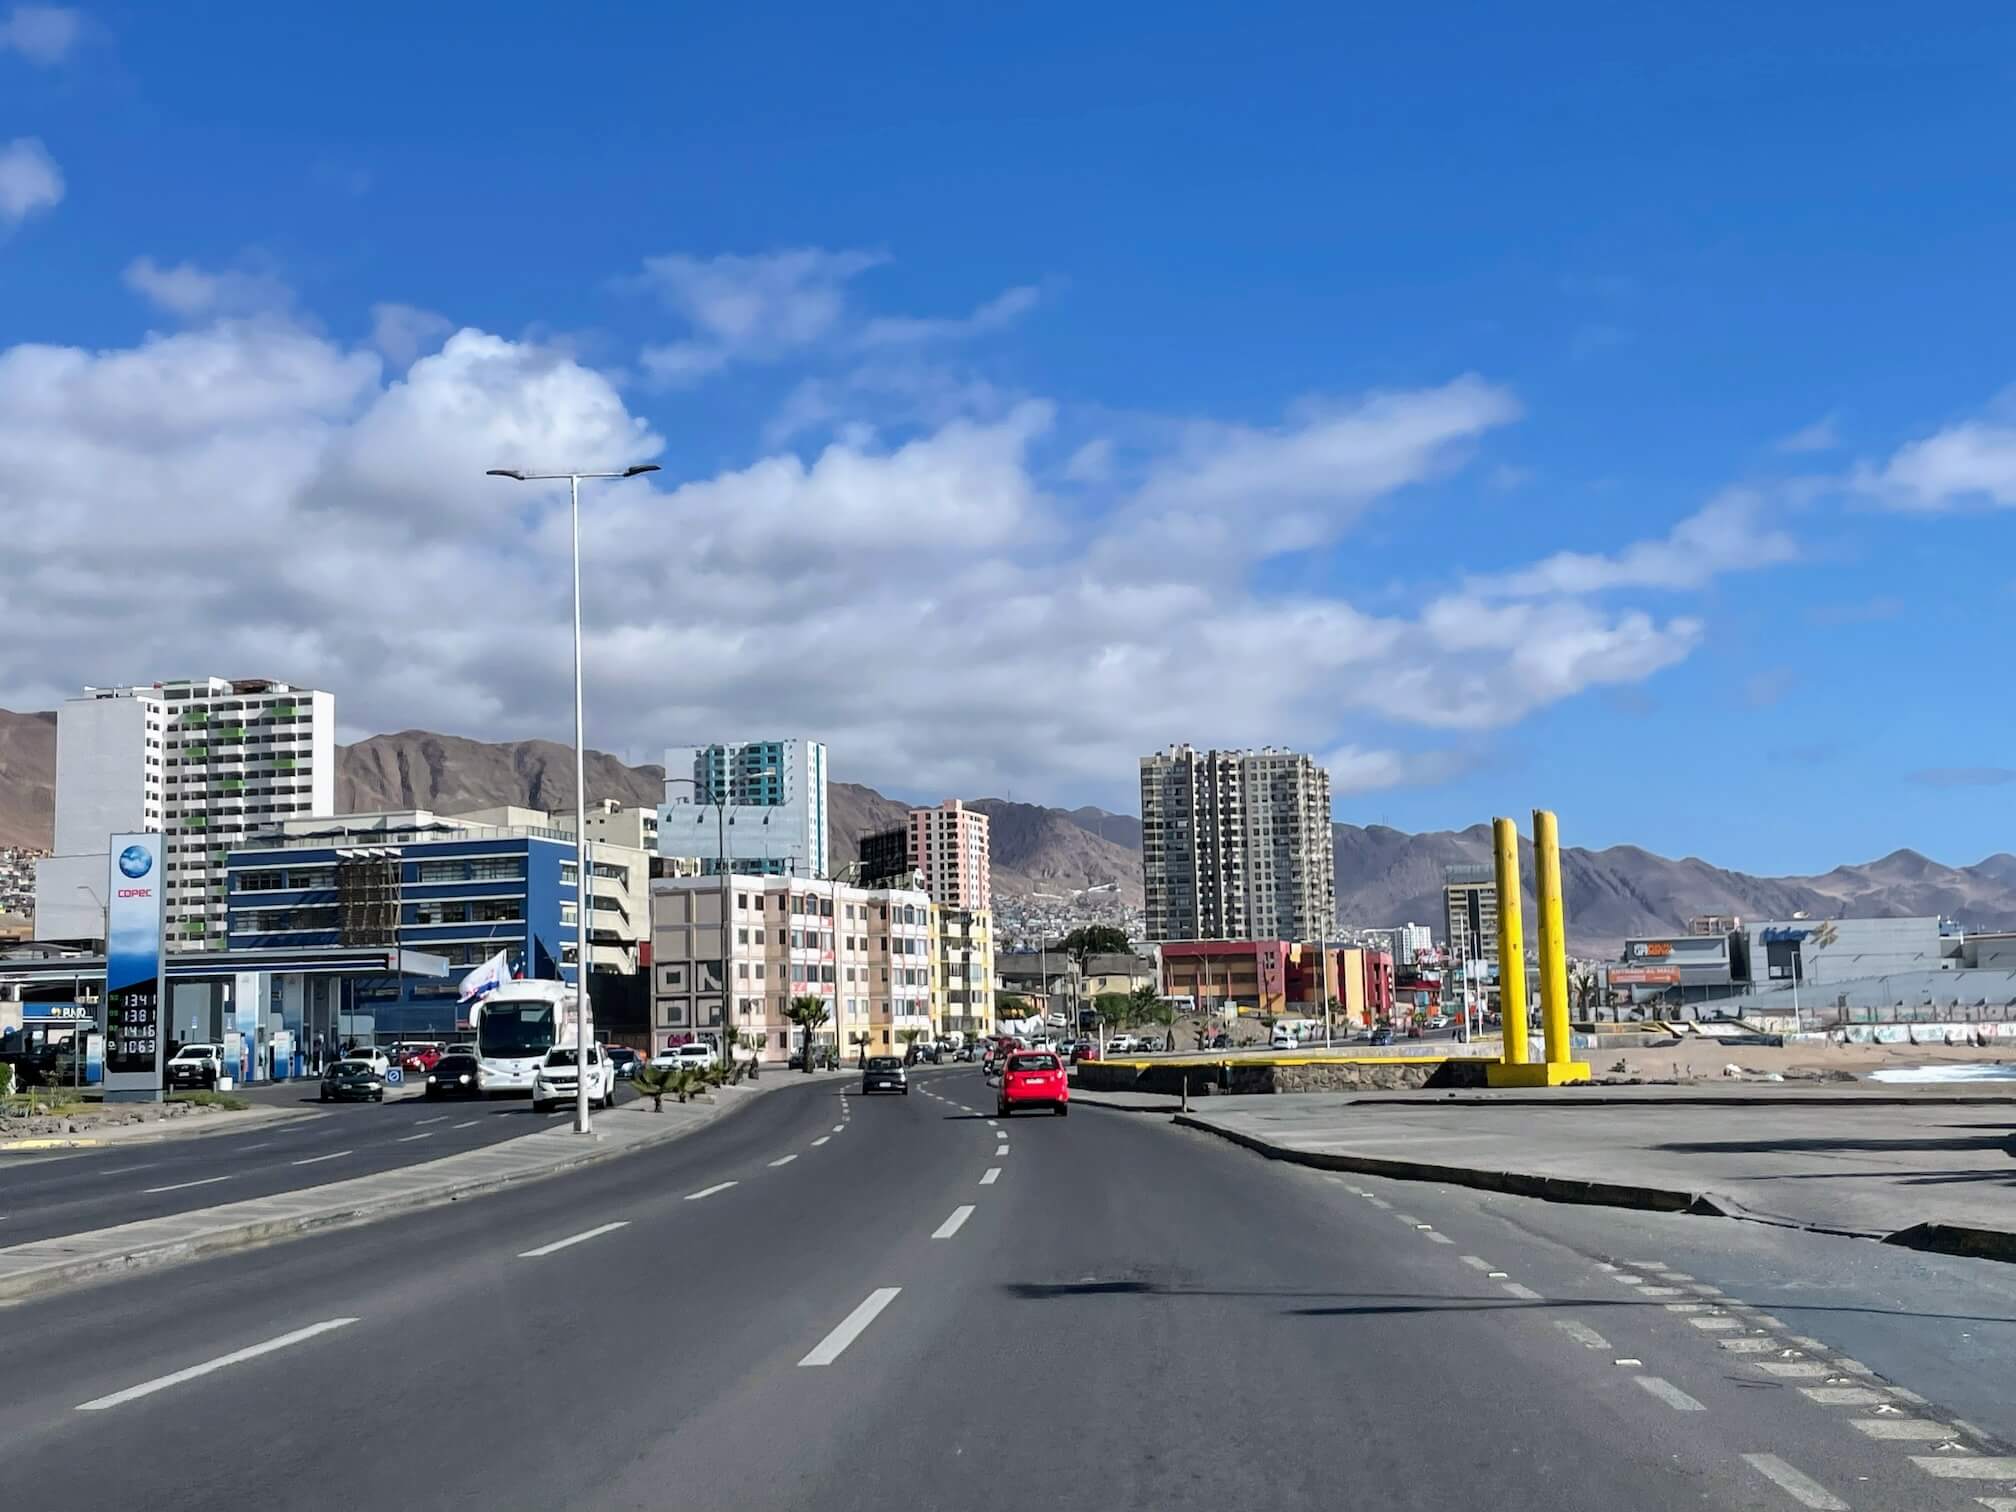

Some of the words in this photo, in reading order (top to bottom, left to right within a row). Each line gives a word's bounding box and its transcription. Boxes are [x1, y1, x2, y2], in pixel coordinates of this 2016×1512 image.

[118, 889, 152, 898] COPEC
[124, 993, 157, 1007] 1341
[124, 1009, 156, 1023] 1381
[124, 1024, 156, 1038] 1416
[123, 1040, 156, 1054] 1063
